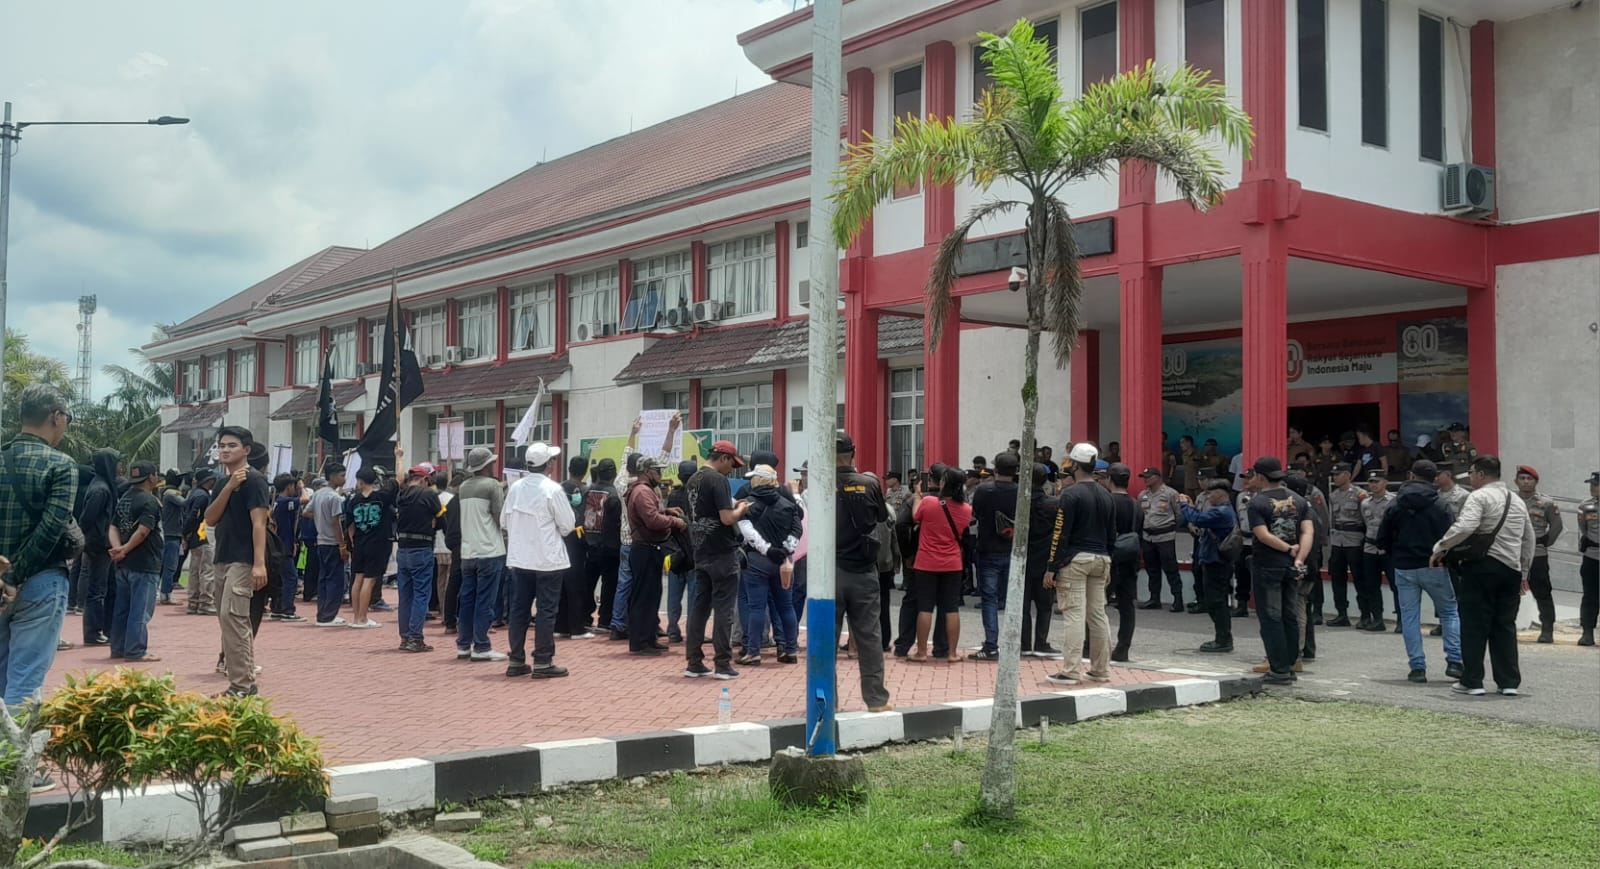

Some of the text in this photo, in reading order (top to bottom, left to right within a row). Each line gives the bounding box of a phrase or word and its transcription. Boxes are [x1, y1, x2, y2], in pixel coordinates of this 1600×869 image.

[1402, 325, 1438, 357] 80
[1287, 338, 1304, 383] 0
[1307, 360, 1373, 375] Indonesia Maju
[1048, 508, 1064, 562] GREENLIGHT
